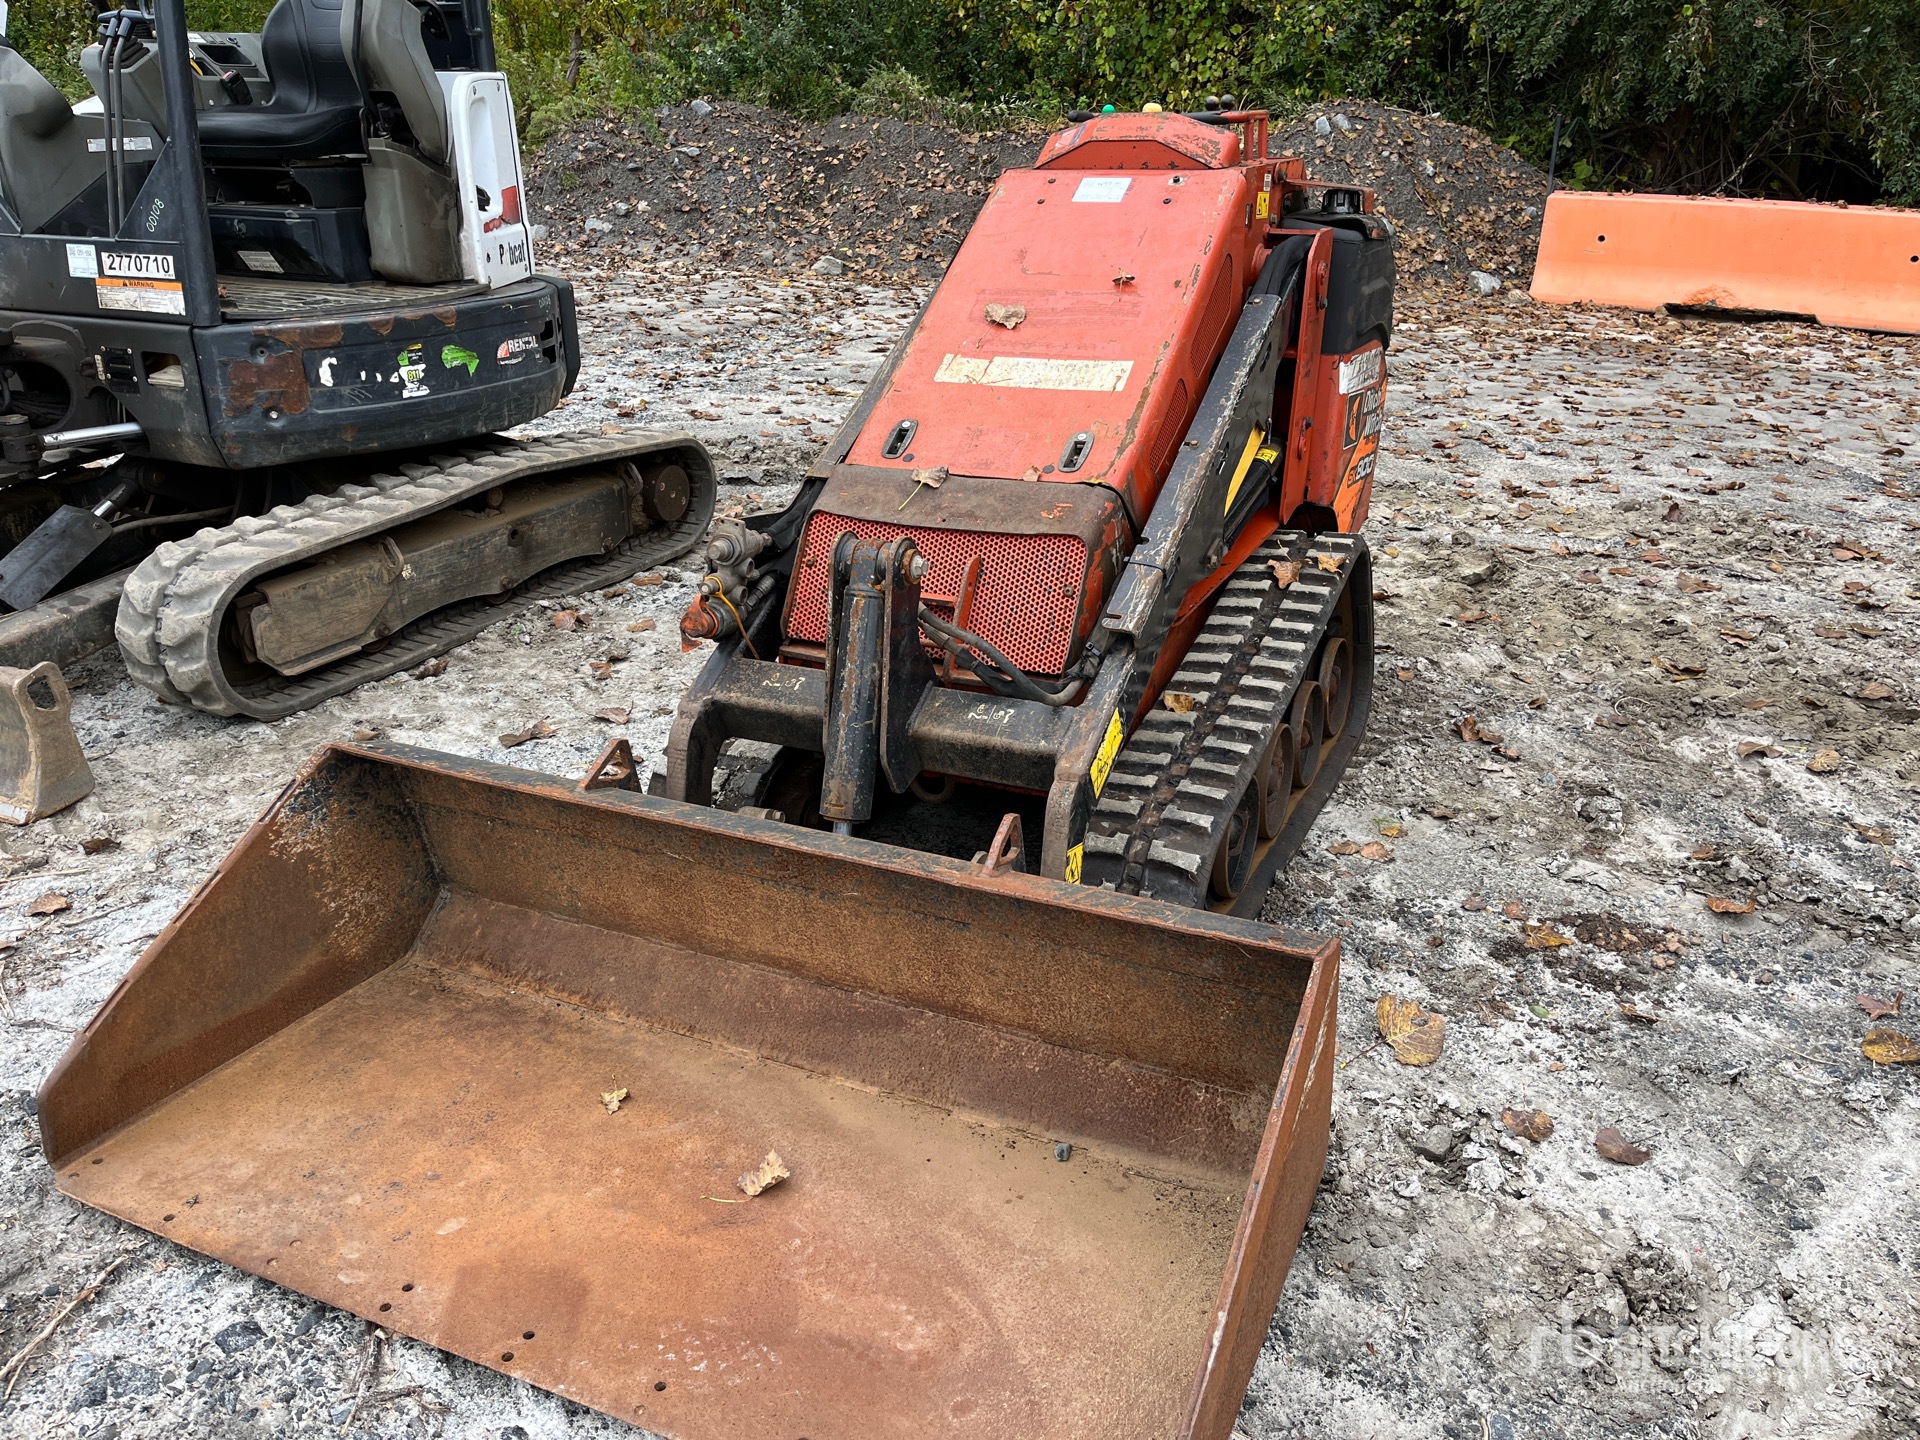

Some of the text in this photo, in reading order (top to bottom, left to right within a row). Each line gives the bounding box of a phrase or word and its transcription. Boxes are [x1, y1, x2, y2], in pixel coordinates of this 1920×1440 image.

[146, 198, 165, 232] 00108
[107, 254, 169, 273] 2770710
[407, 369, 420, 382] 811
